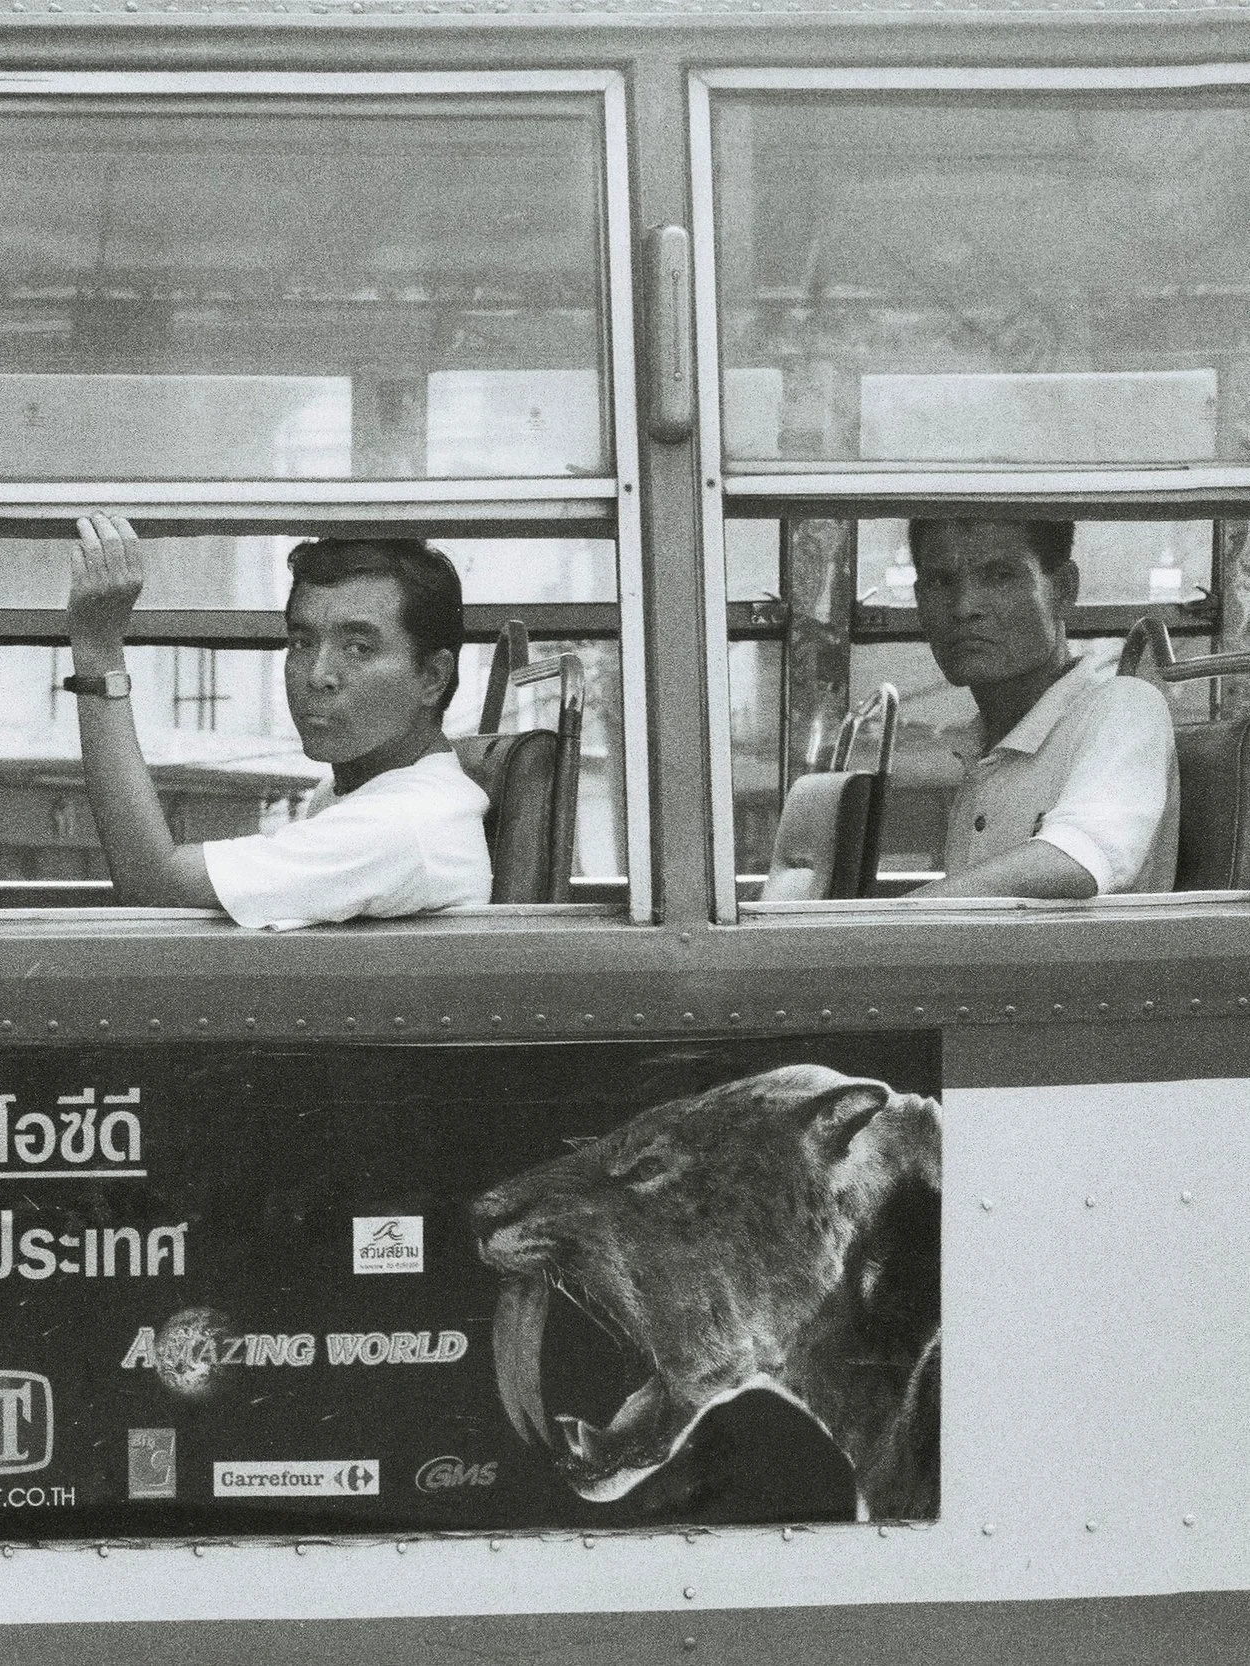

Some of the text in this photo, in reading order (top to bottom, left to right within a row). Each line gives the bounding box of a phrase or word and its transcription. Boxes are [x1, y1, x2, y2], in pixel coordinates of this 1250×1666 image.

[121, 1327, 468, 1368] AMAZING WORLD
[221, 1471, 324, 1488] Carrefour
[425, 1461, 498, 1489] GMS
